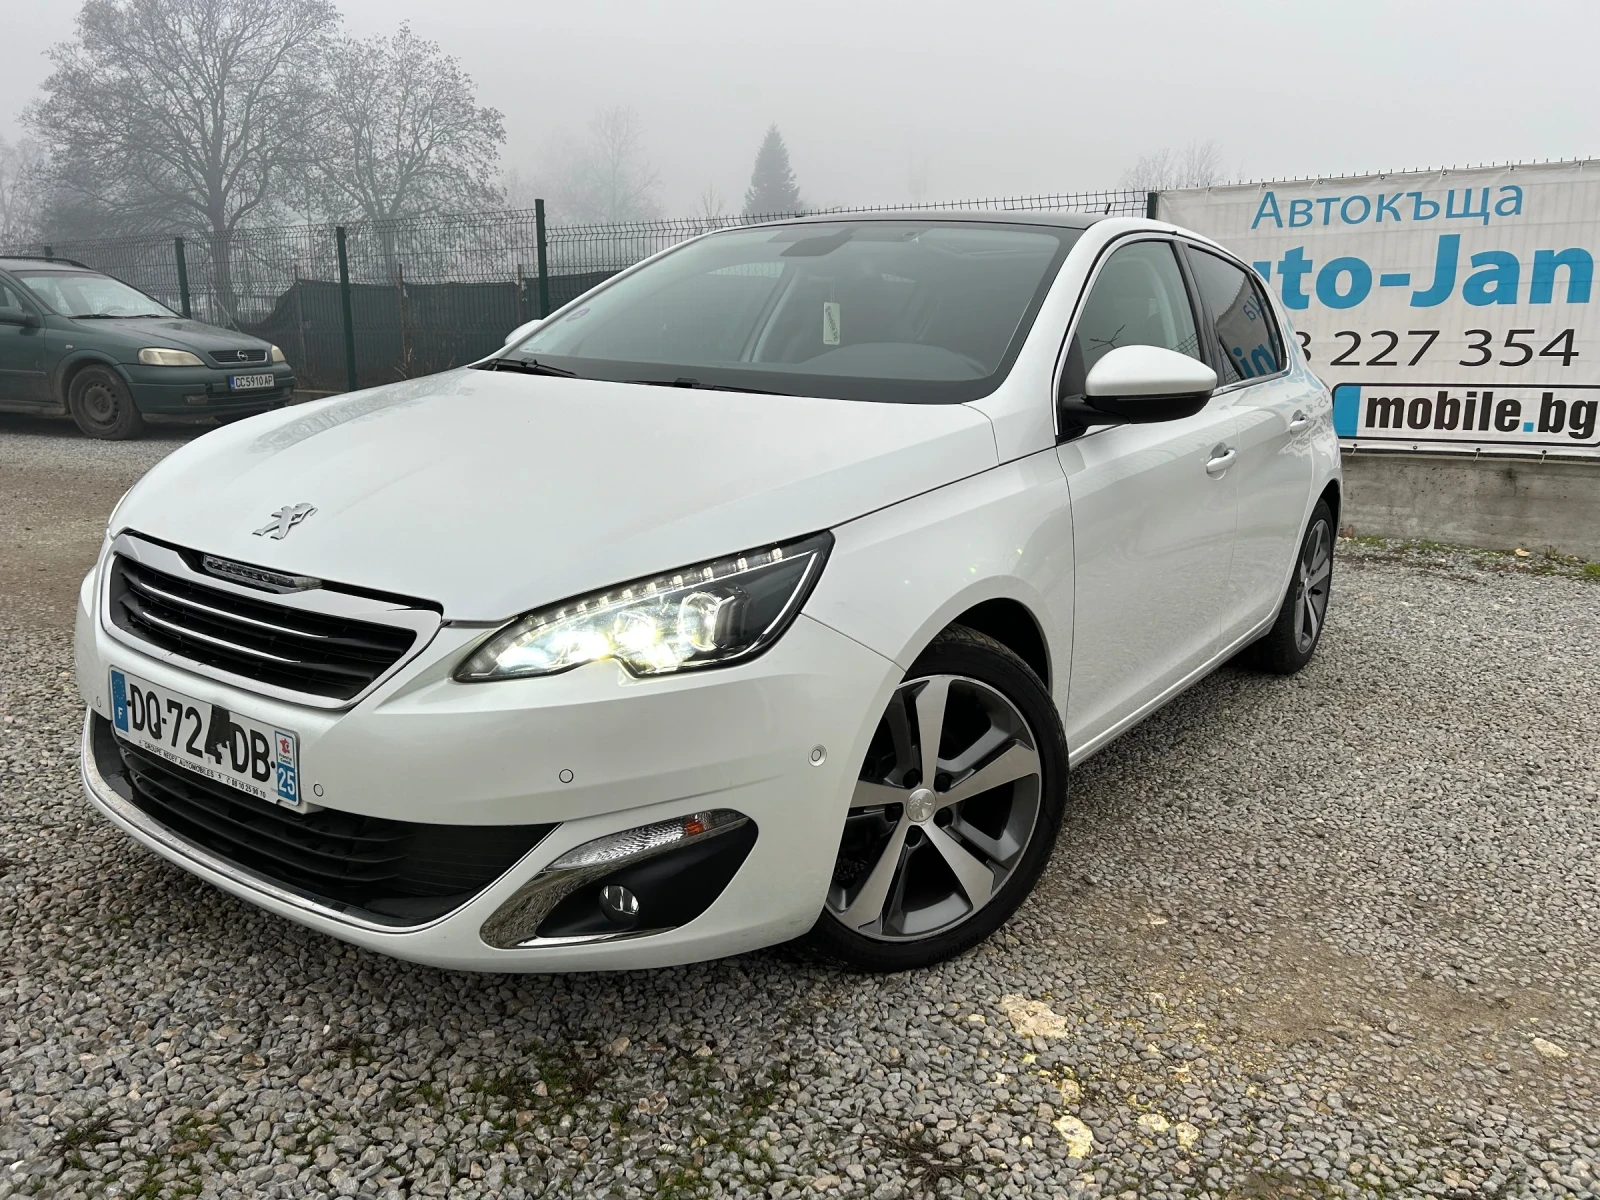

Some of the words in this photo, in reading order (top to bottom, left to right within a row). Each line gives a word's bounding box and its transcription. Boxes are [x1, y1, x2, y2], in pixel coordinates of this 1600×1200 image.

[1251, 184, 1523, 229] Автокъща
[1330, 330, 1440, 366] 227
[1458, 328, 1579, 366] 354
[1365, 391, 1598, 439] mobile.bg
[118, 706, 124, 720] F
[278, 766, 295, 796] 25
